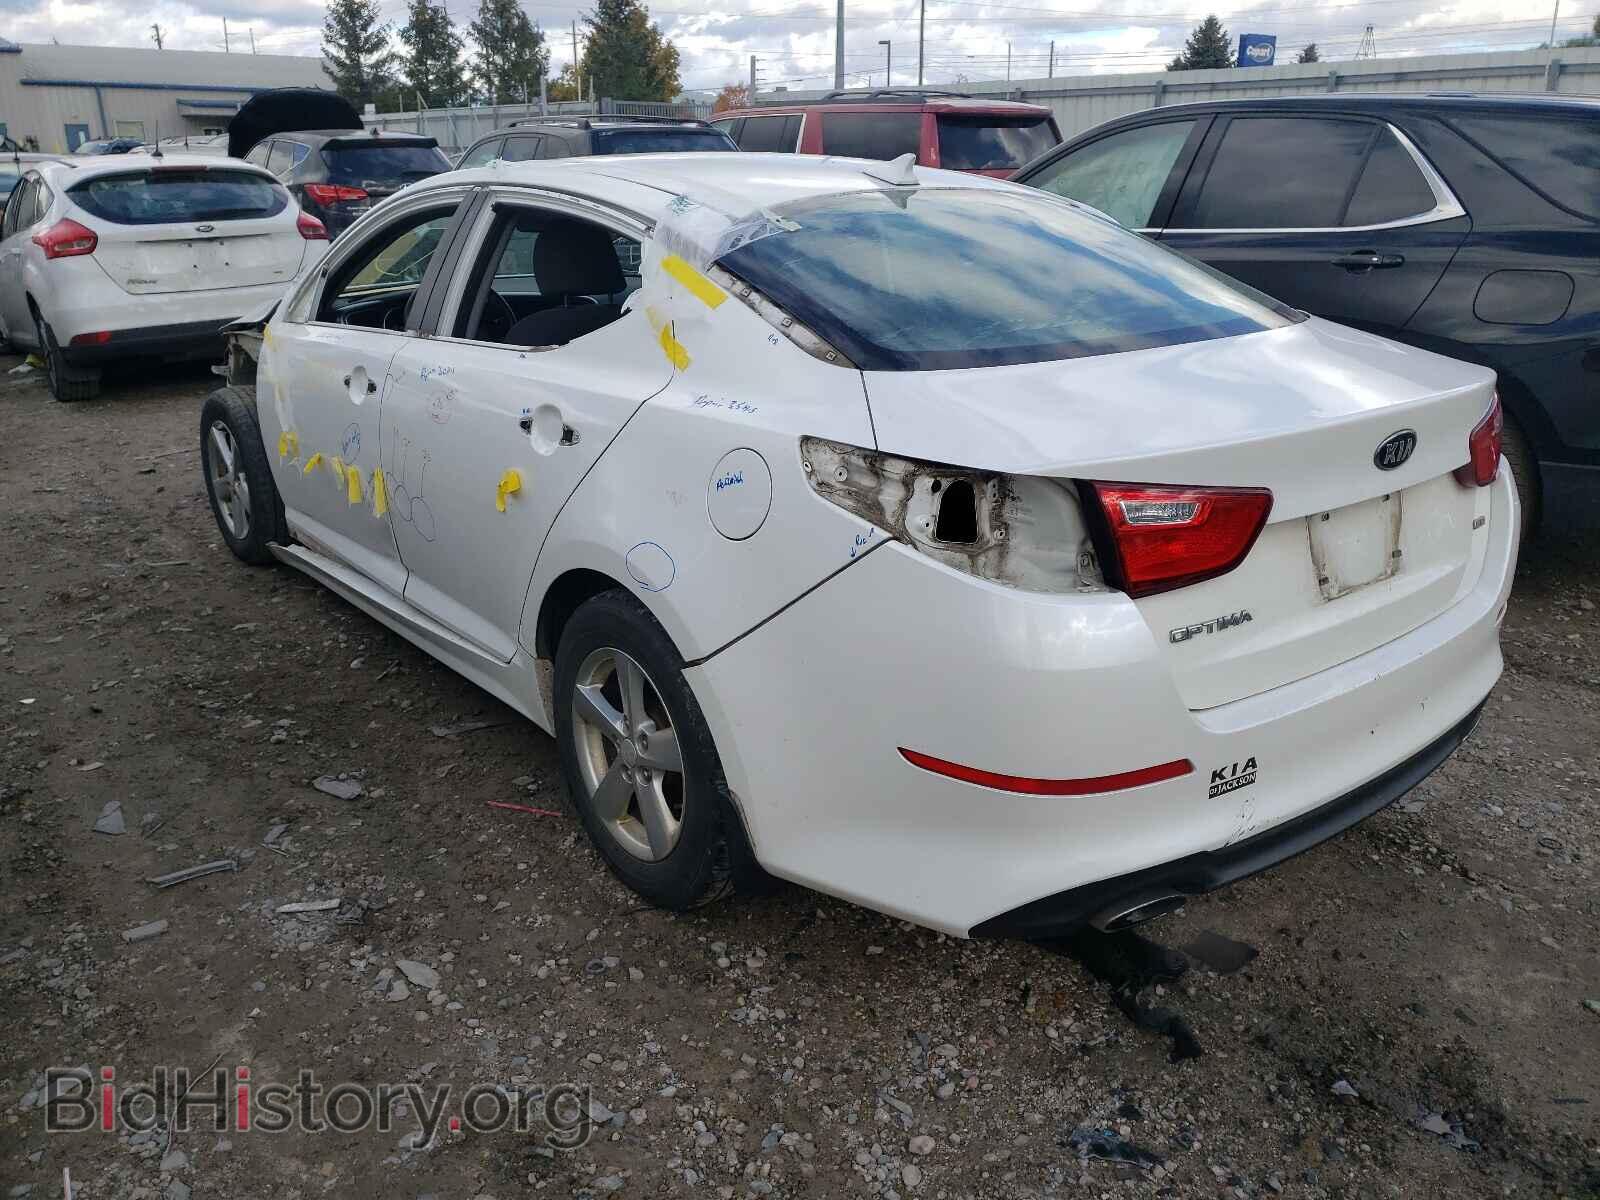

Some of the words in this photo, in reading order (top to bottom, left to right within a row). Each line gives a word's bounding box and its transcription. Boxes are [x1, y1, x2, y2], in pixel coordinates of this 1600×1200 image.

[1383, 437, 1412, 465] KIA
[1169, 609, 1253, 643] OPTIMA
[1210, 756, 1258, 784] KIA
[1217, 773, 1257, 795] JACKSON
